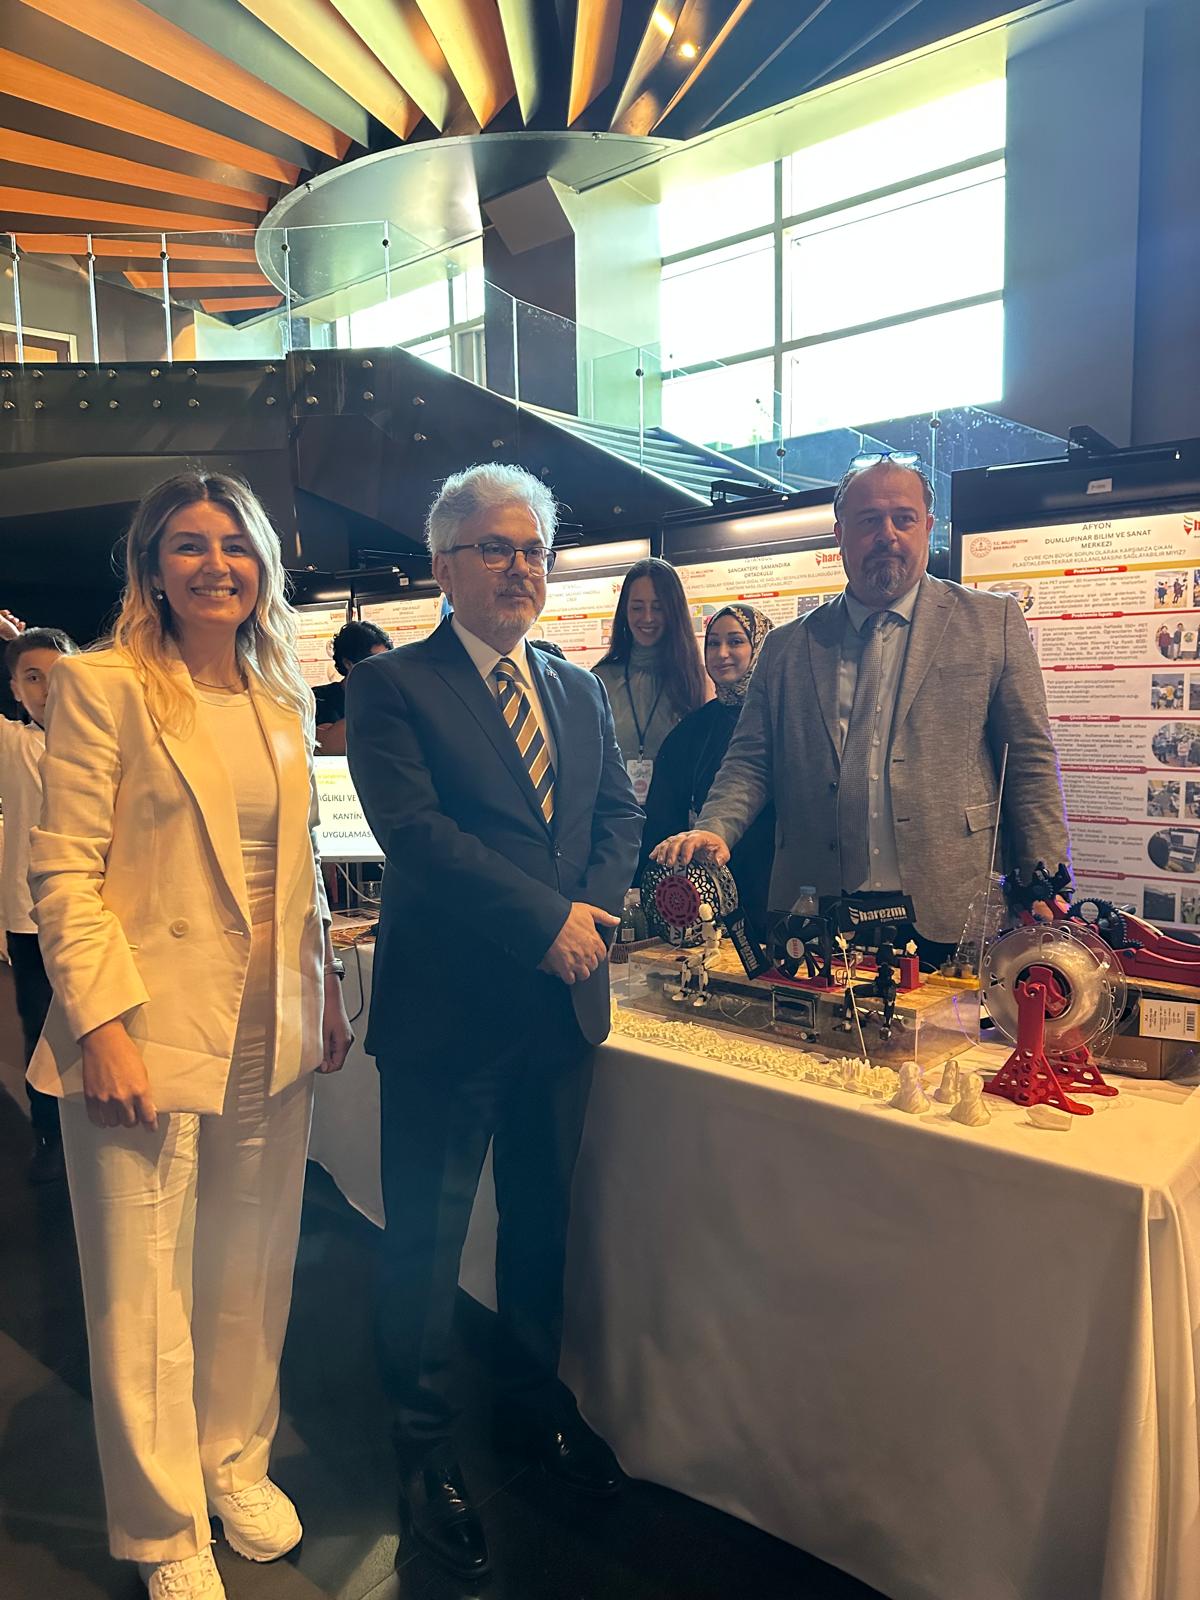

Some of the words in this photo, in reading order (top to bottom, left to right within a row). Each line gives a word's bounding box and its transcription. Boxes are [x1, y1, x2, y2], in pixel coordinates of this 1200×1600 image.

[1082, 522, 1112, 531] AFYON
[1045, 534, 1092, 545] DUMLUPINAR
[1115, 531, 1126, 539] VE
[1126, 530, 1151, 538] SANAT
[822, 553, 842, 563] hare
[319, 793, 345, 802] ĞLIKLI
[347, 794, 357, 802] VE
